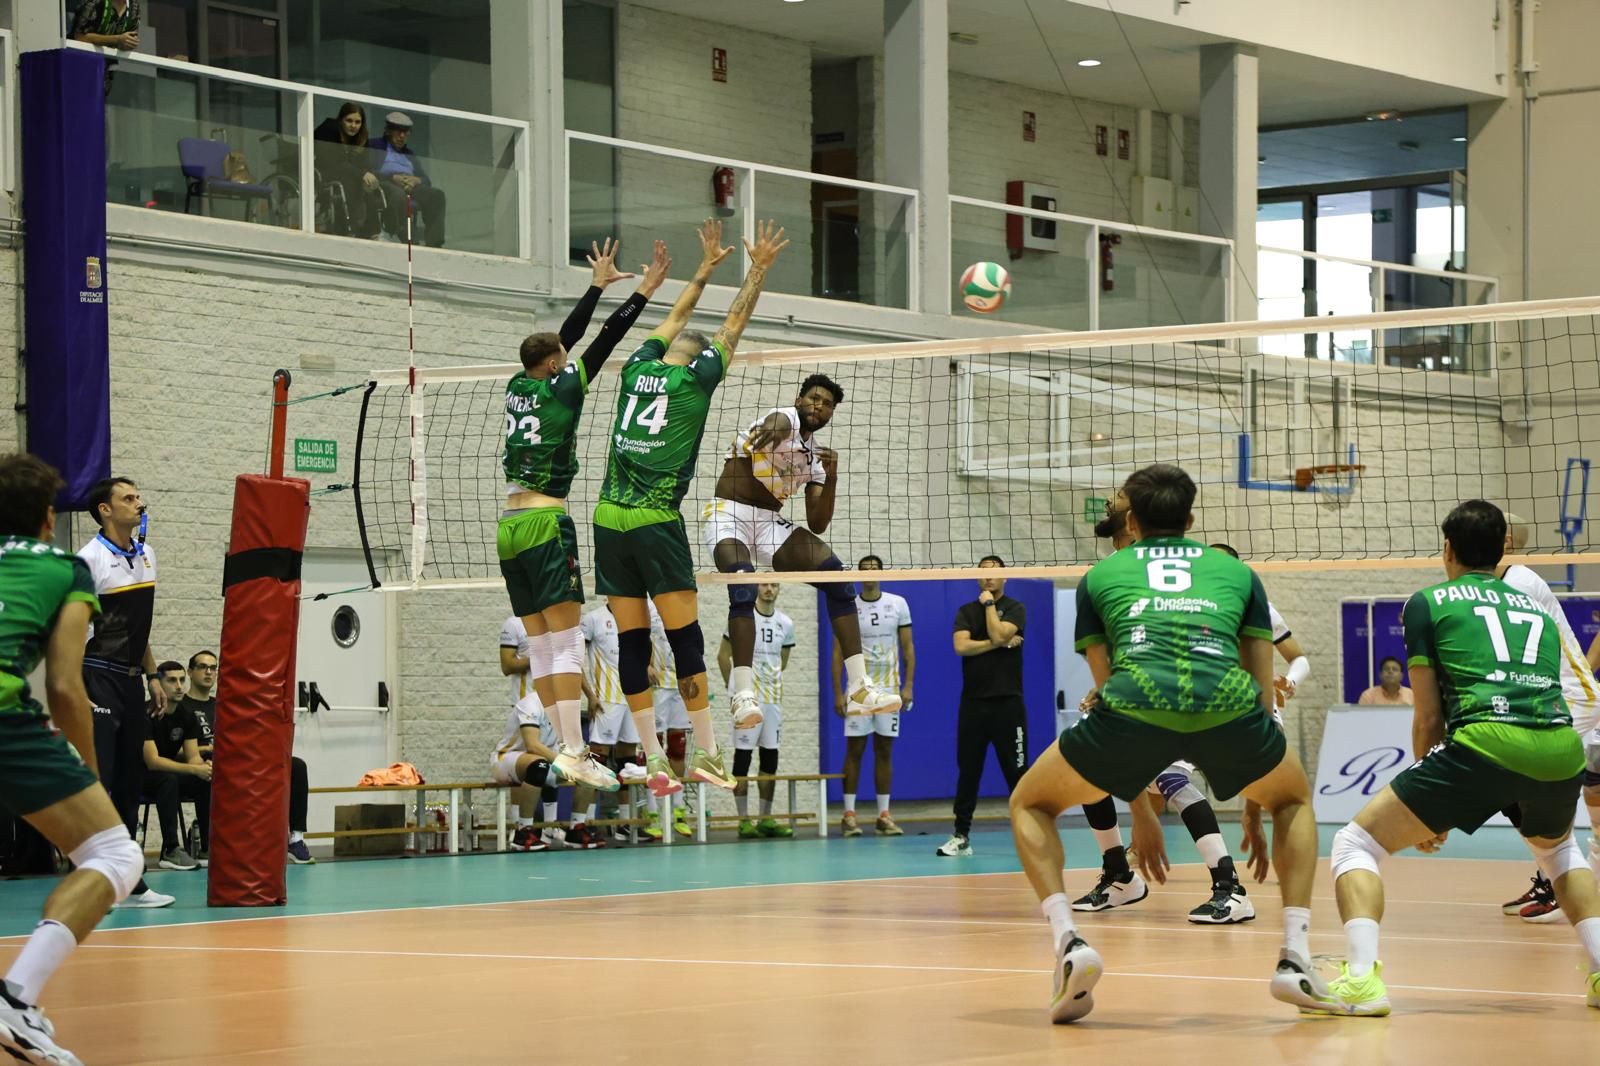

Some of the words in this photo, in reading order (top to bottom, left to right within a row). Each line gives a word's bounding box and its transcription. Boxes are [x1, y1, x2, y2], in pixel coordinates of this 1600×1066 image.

[634, 374, 668, 393] RUIZ
[620, 393, 669, 435] 14
[298, 441, 324, 454] SALIDA
[324, 443, 334, 455] DE
[621, 443, 650, 455] Unicaja
[623, 437, 666, 447] Fundación
[297, 455, 336, 469] EMERGENCIA
[1134, 546, 1203, 560] TODD
[1146, 558, 1192, 593] 6
[1433, 585, 1501, 606] PAULO
[1503, 592, 1548, 615] REN
[870, 612, 880, 626] 2
[760, 627, 774, 643] 13
[1473, 605, 1545, 665] 17
[891, 717, 899, 733] 2
[1319, 746, 1406, 796] R
